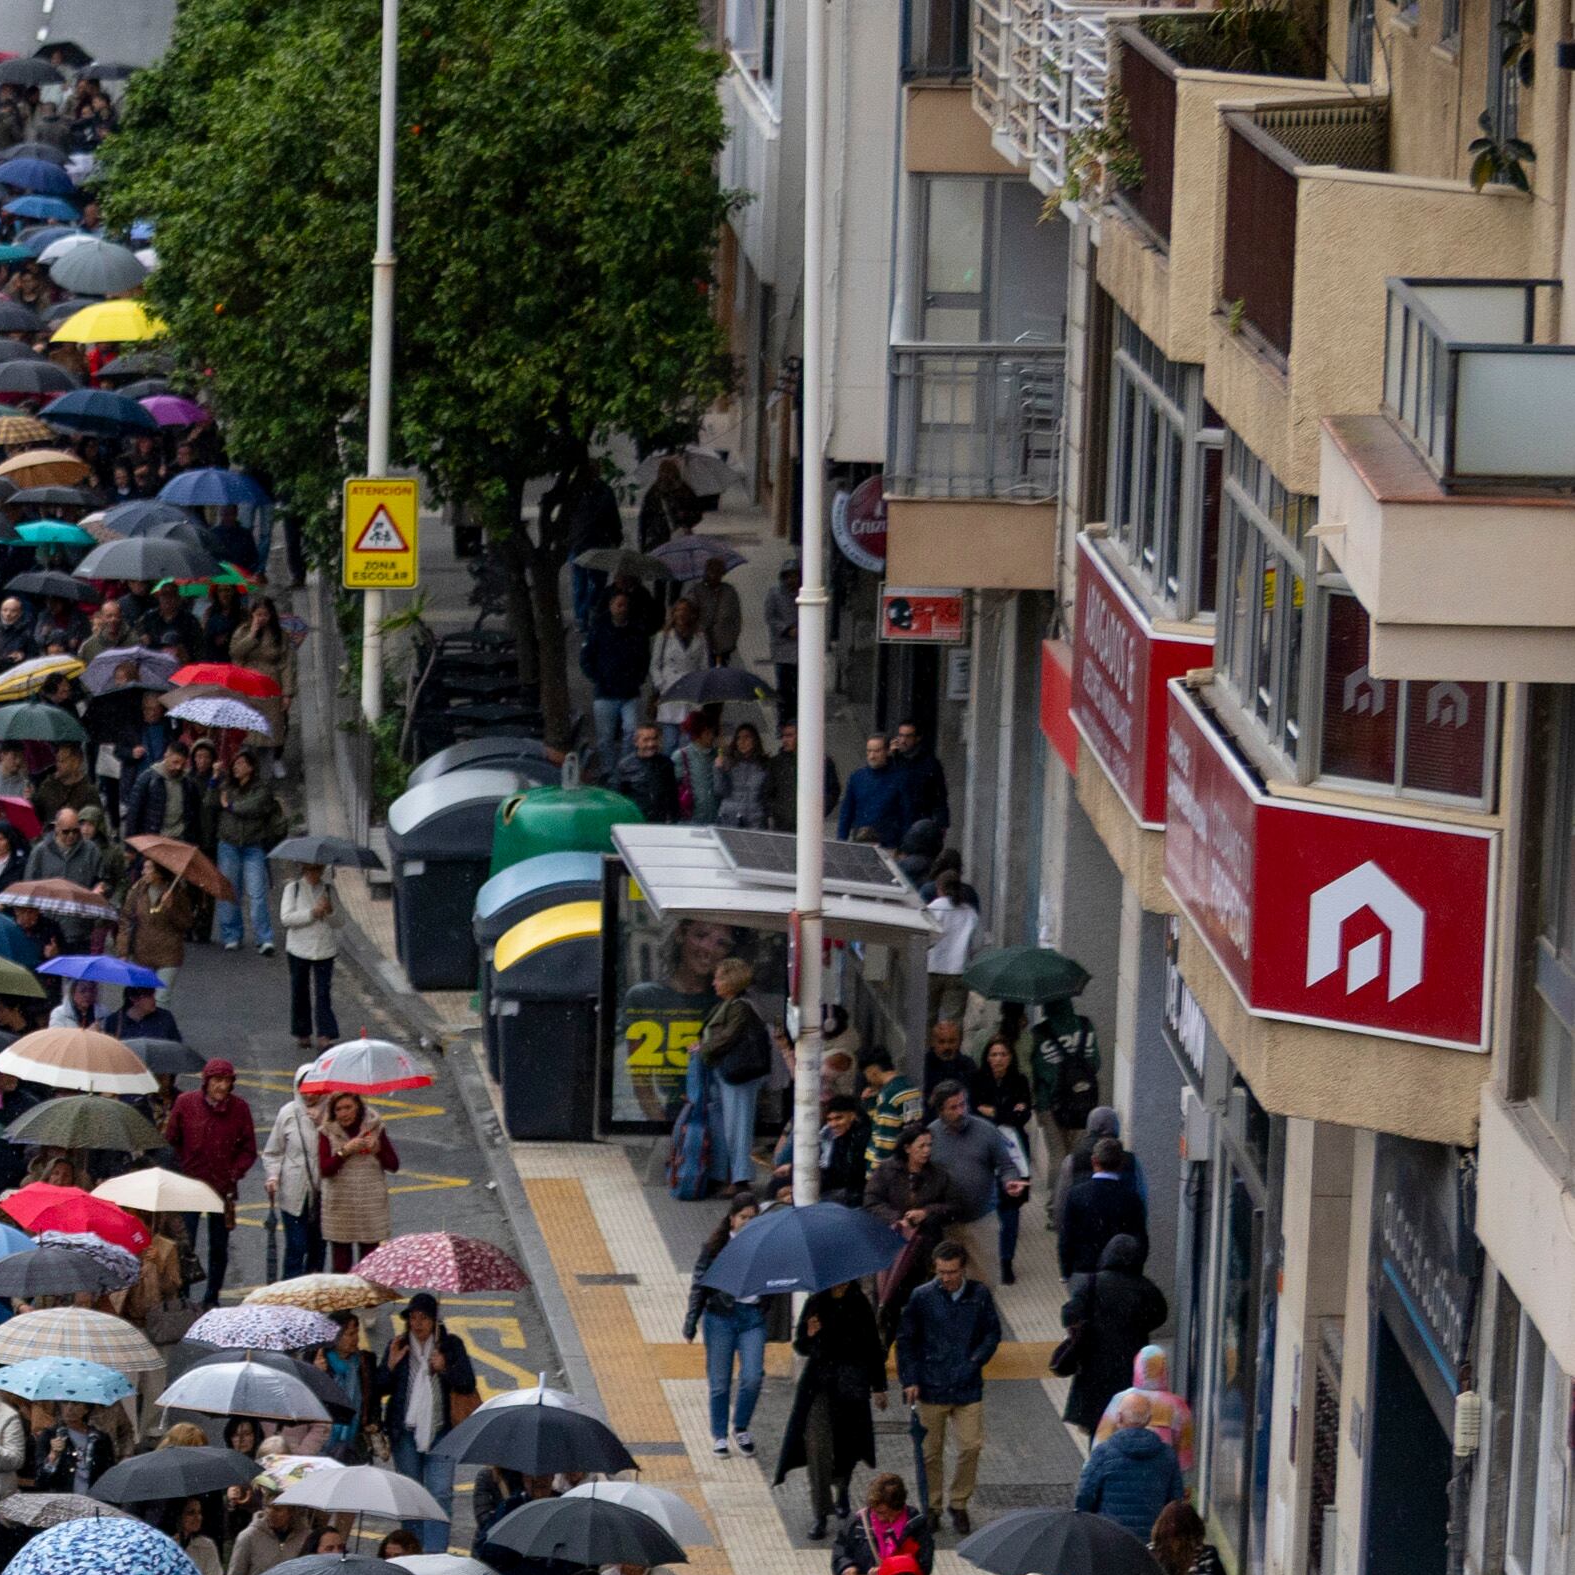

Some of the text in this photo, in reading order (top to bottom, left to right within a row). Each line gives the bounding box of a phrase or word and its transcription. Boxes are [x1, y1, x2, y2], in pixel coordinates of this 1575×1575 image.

[351, 485, 412, 496] ATENCIÓN
[364, 561, 397, 570] ZONA
[352, 572, 408, 580] ESCOLAR
[625, 1020, 705, 1067] 25
